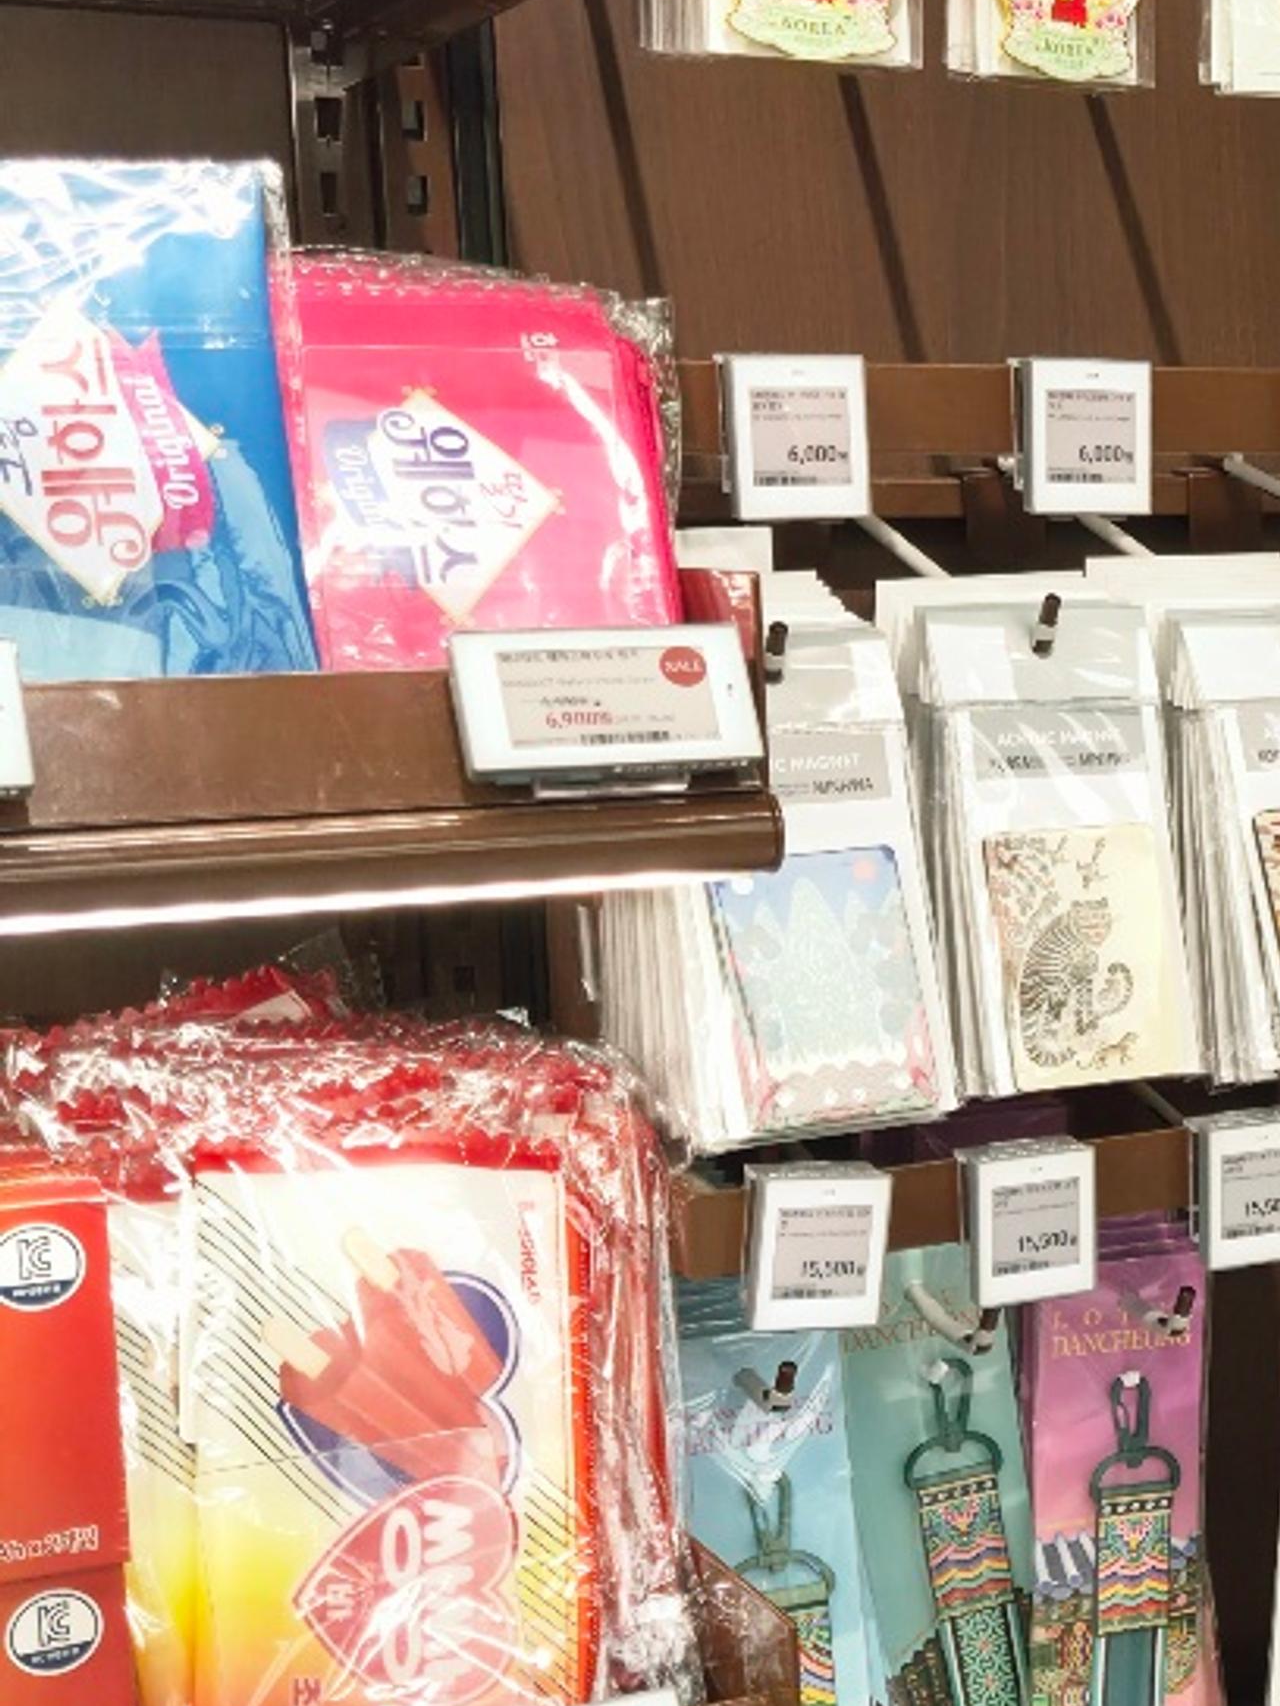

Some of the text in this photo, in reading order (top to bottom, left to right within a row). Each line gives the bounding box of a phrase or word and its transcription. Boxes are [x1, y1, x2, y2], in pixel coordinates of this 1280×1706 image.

[38, 338, 150, 573] 웨하스
[128, 371, 201, 510] Original
[380, 403, 482, 586] 웨하스
